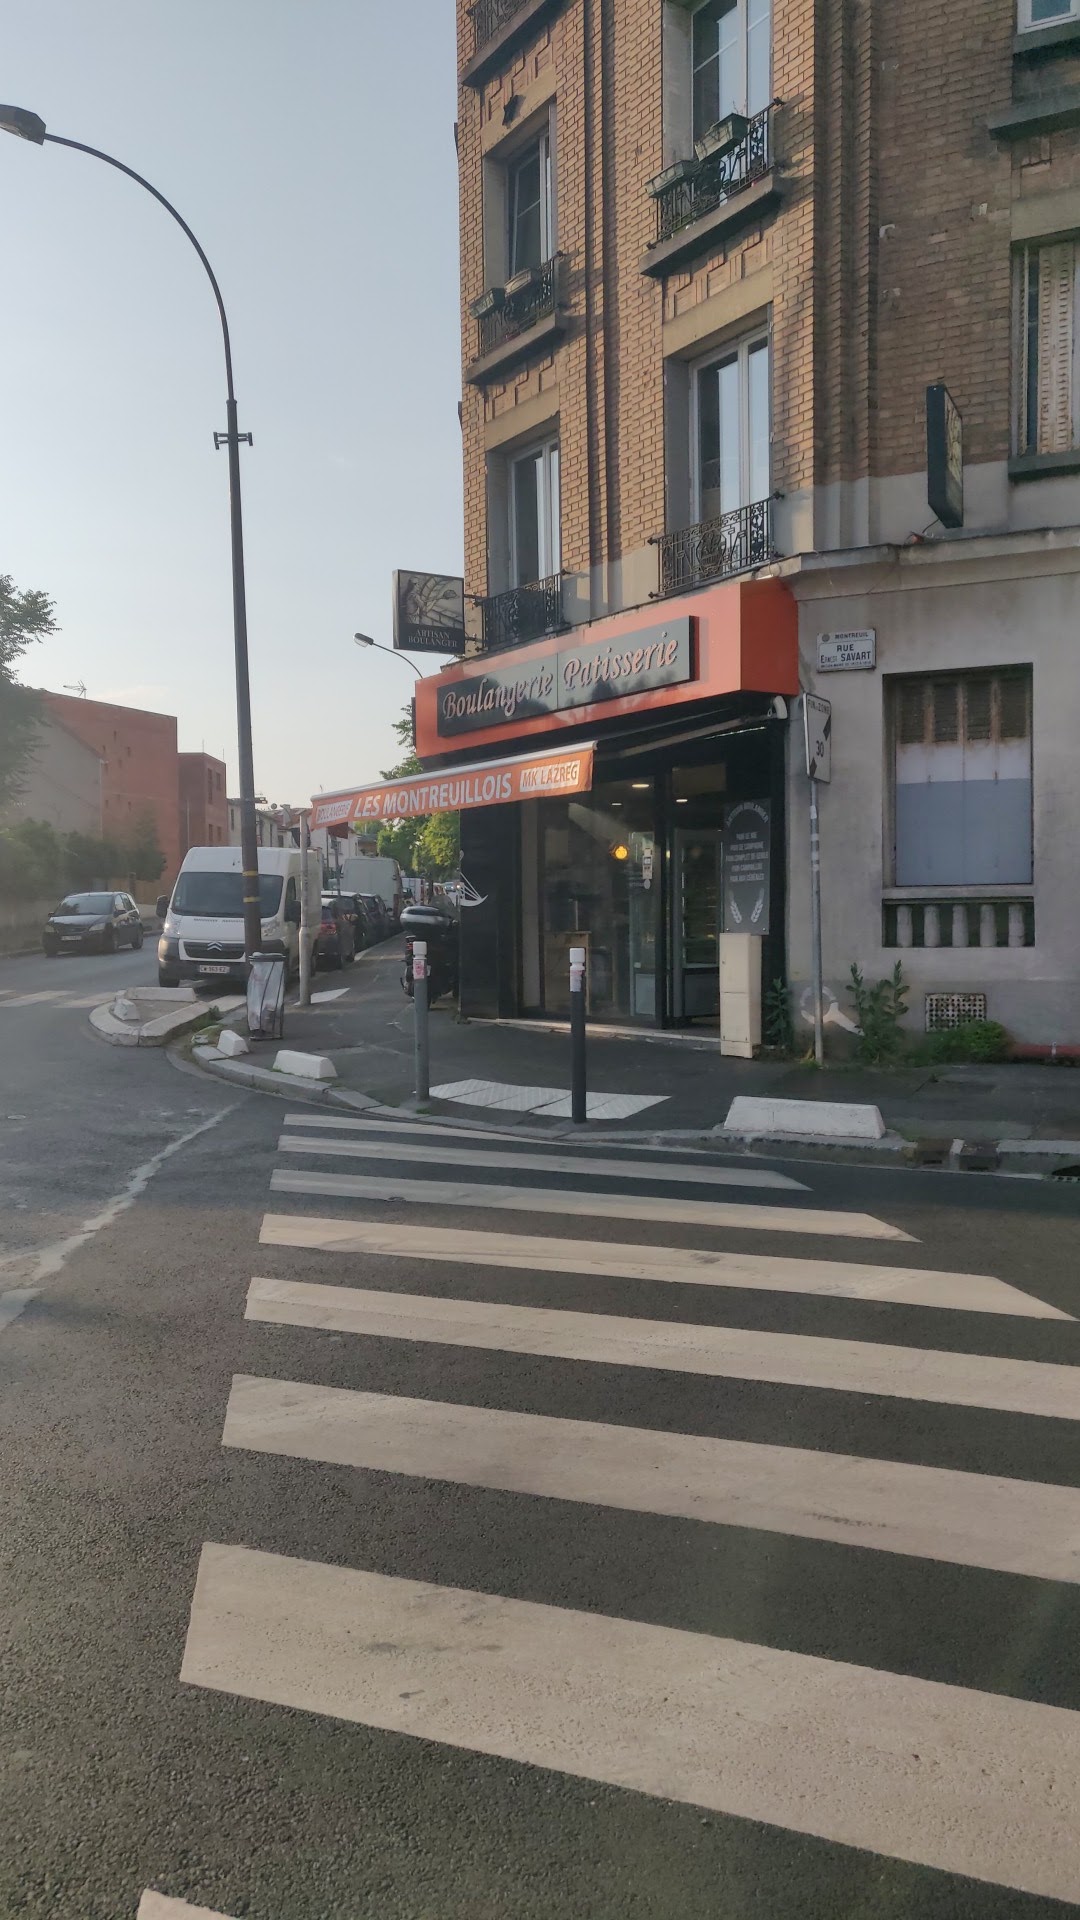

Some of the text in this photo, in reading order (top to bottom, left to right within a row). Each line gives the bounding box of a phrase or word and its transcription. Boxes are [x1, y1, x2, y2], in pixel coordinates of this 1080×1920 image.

[416, 629, 450, 639] ARTISAN
[835, 632, 869, 640] MONTREUIL
[408, 636, 458, 648] BOULANGER
[837, 644, 854, 652] RUE
[841, 651, 871, 662] SAVART
[443, 631, 679, 717] Boulangerie Patisserie
[816, 740, 824, 757] 30
[354, 794, 380, 818] LES
[382, 773, 512, 814] MONTREUILLOIS
[522, 771, 536, 787] MK
